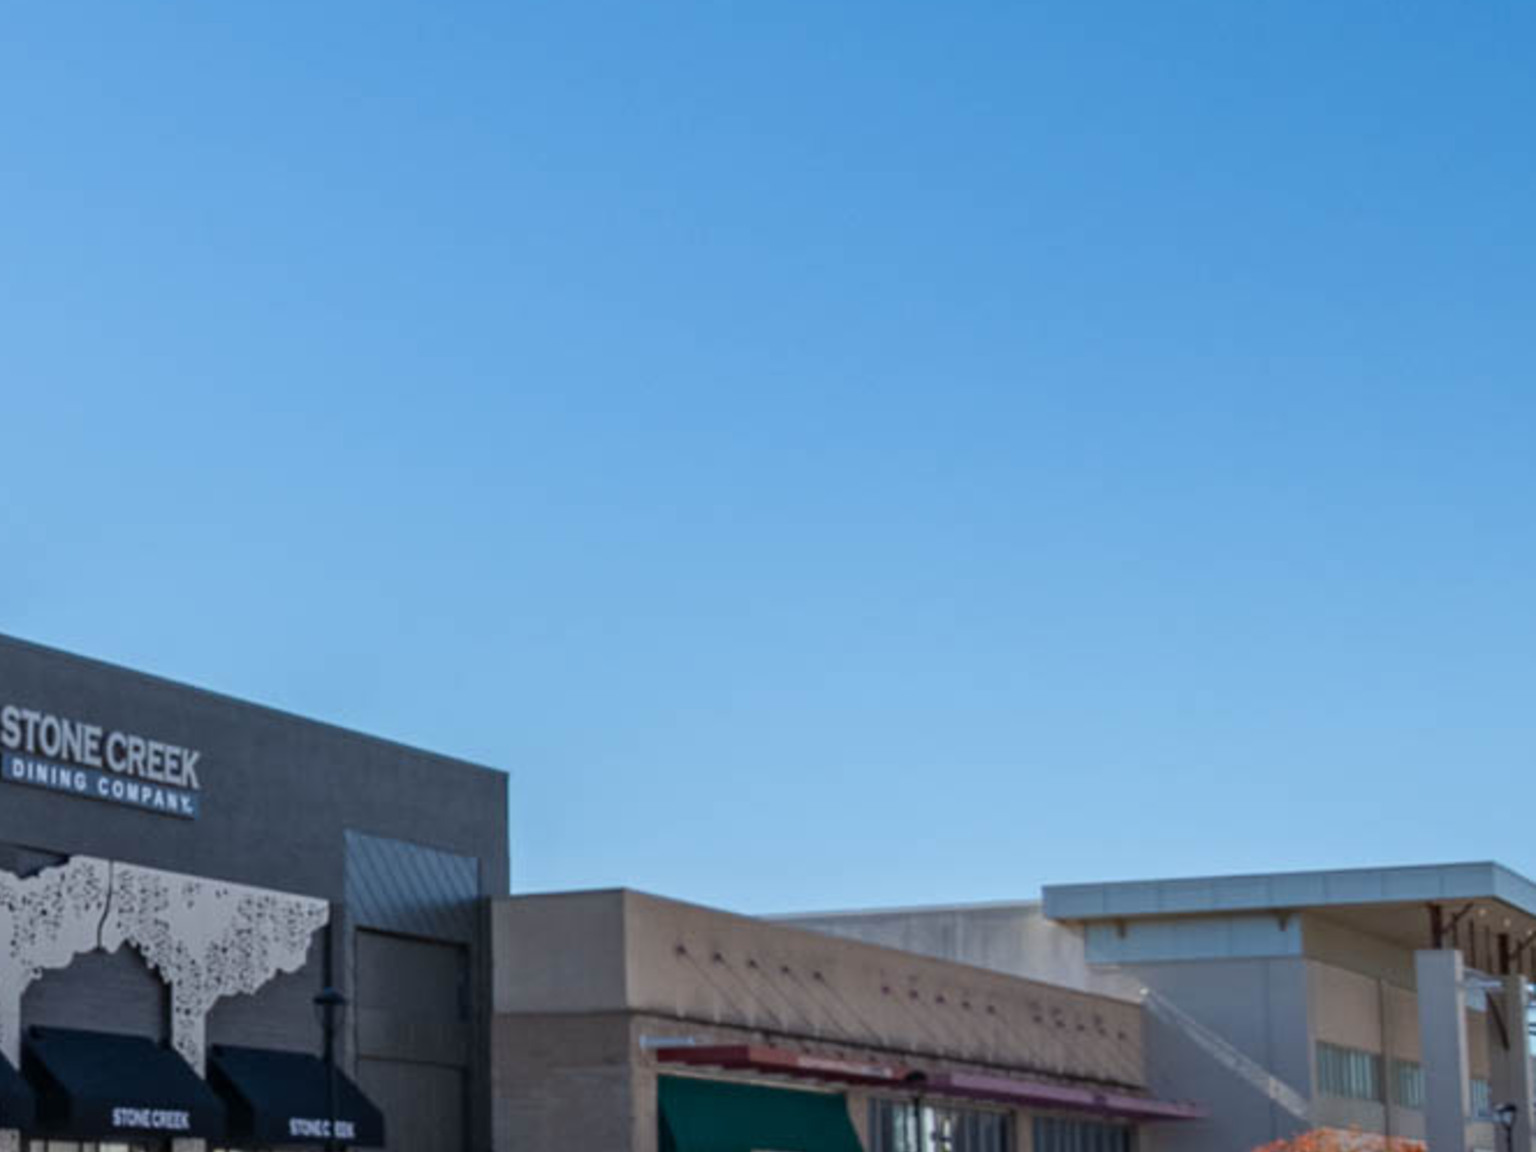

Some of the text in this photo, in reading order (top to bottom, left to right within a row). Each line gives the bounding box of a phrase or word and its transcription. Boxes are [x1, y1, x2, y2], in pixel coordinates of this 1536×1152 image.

[0, 704, 201, 790] STONE CREEK
[11, 757, 88, 791] DINING
[112, 1107, 190, 1130] STONE CREEK
[289, 1117, 356, 1138] STONE CEEK
